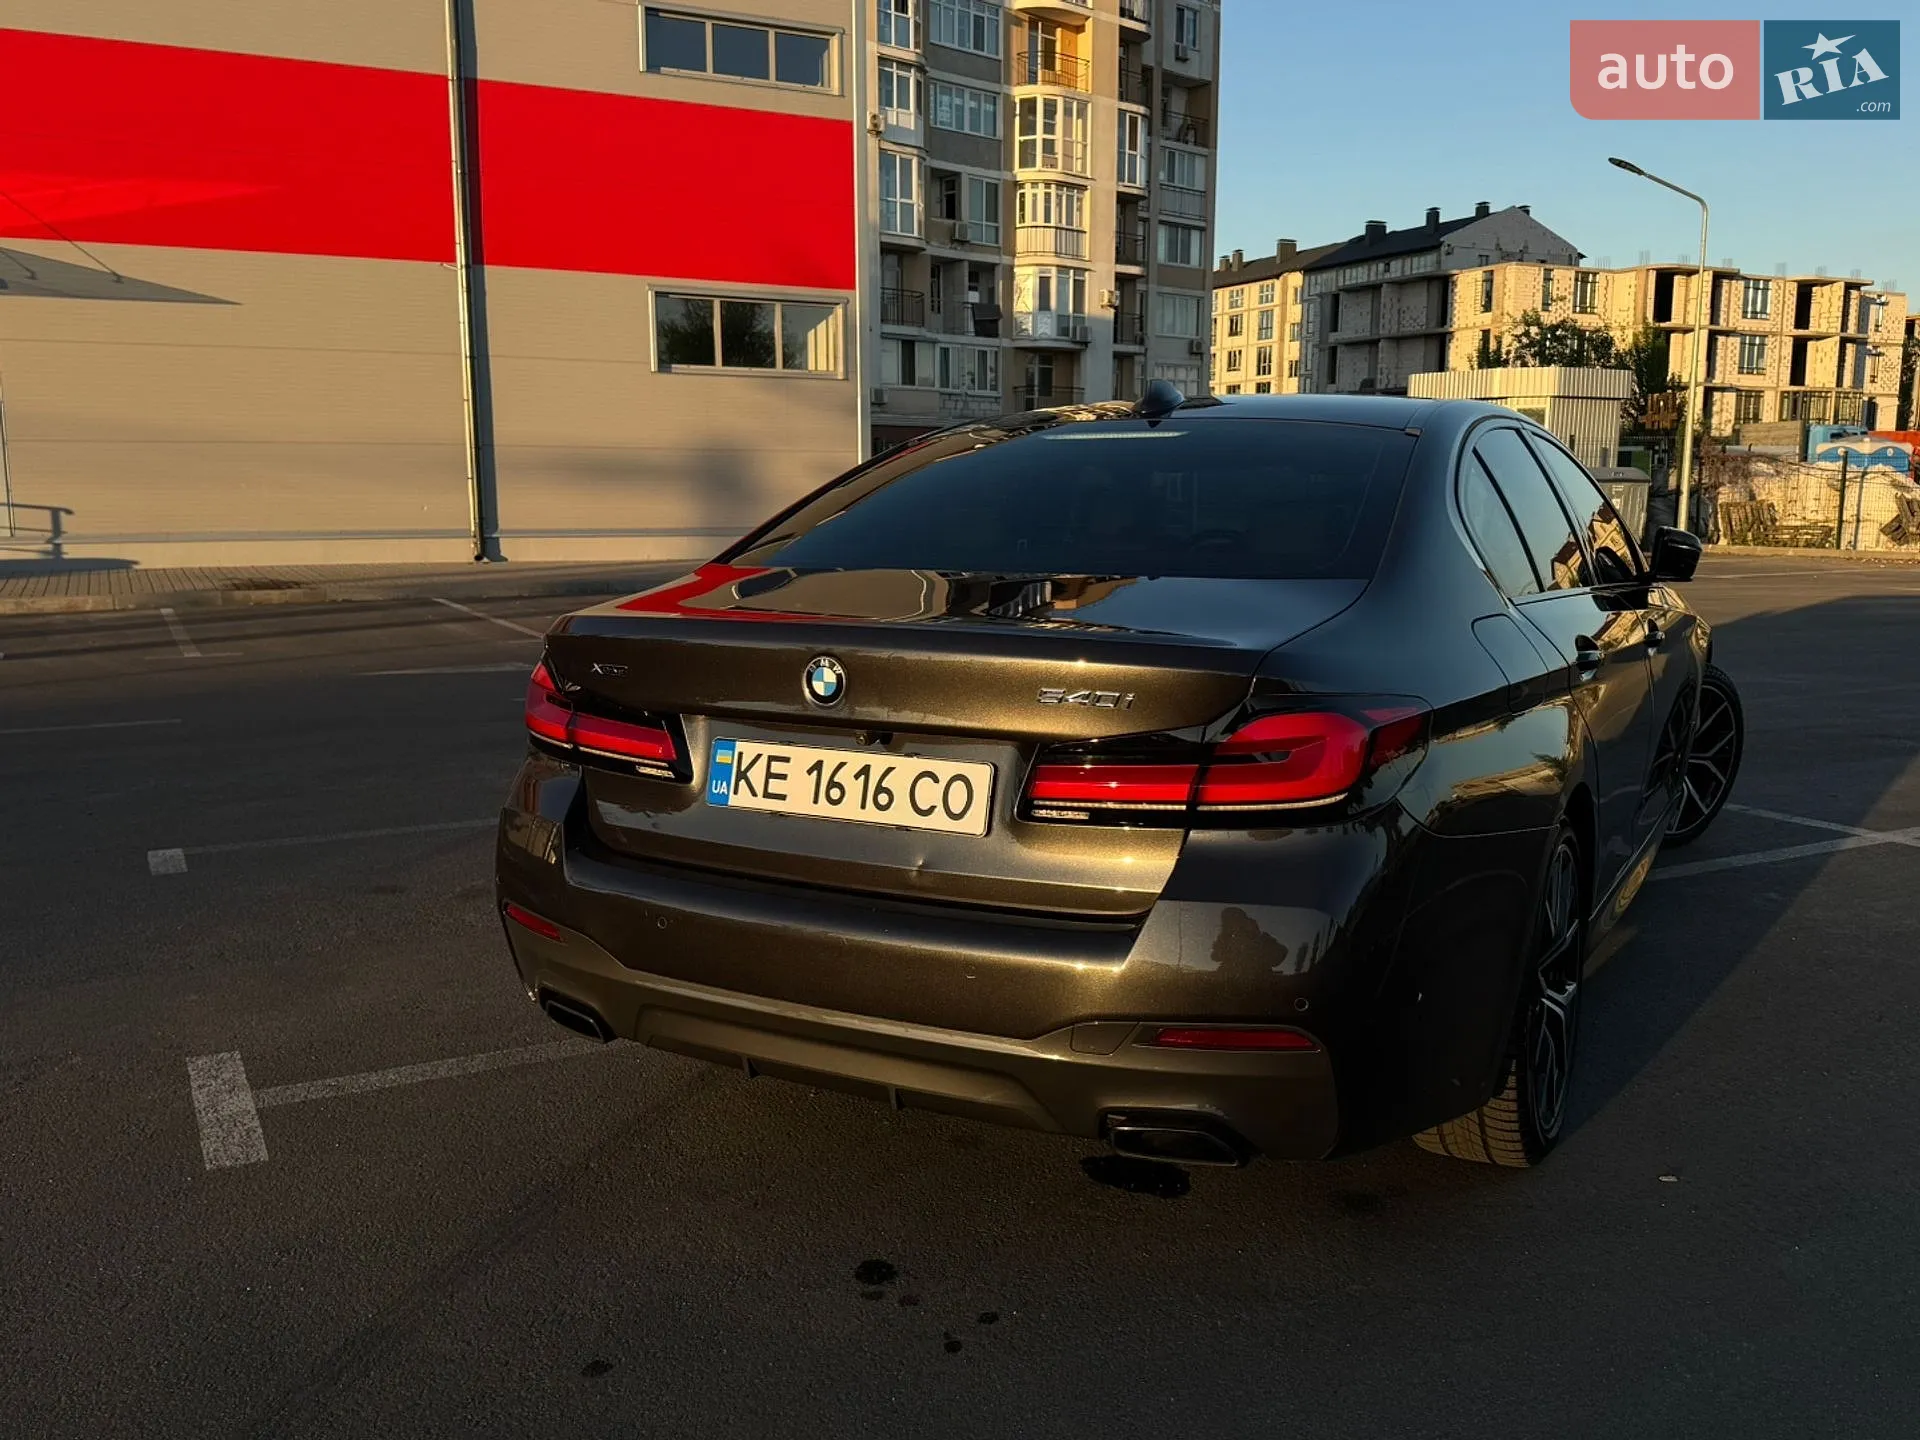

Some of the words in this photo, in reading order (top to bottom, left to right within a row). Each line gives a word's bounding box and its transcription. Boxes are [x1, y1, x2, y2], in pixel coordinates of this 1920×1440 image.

[1038, 687, 1136, 709] 540i
[711, 779, 728, 795] UA
[733, 751, 791, 801] KE
[806, 759, 896, 812] 1616
[909, 770, 974, 821] CO
